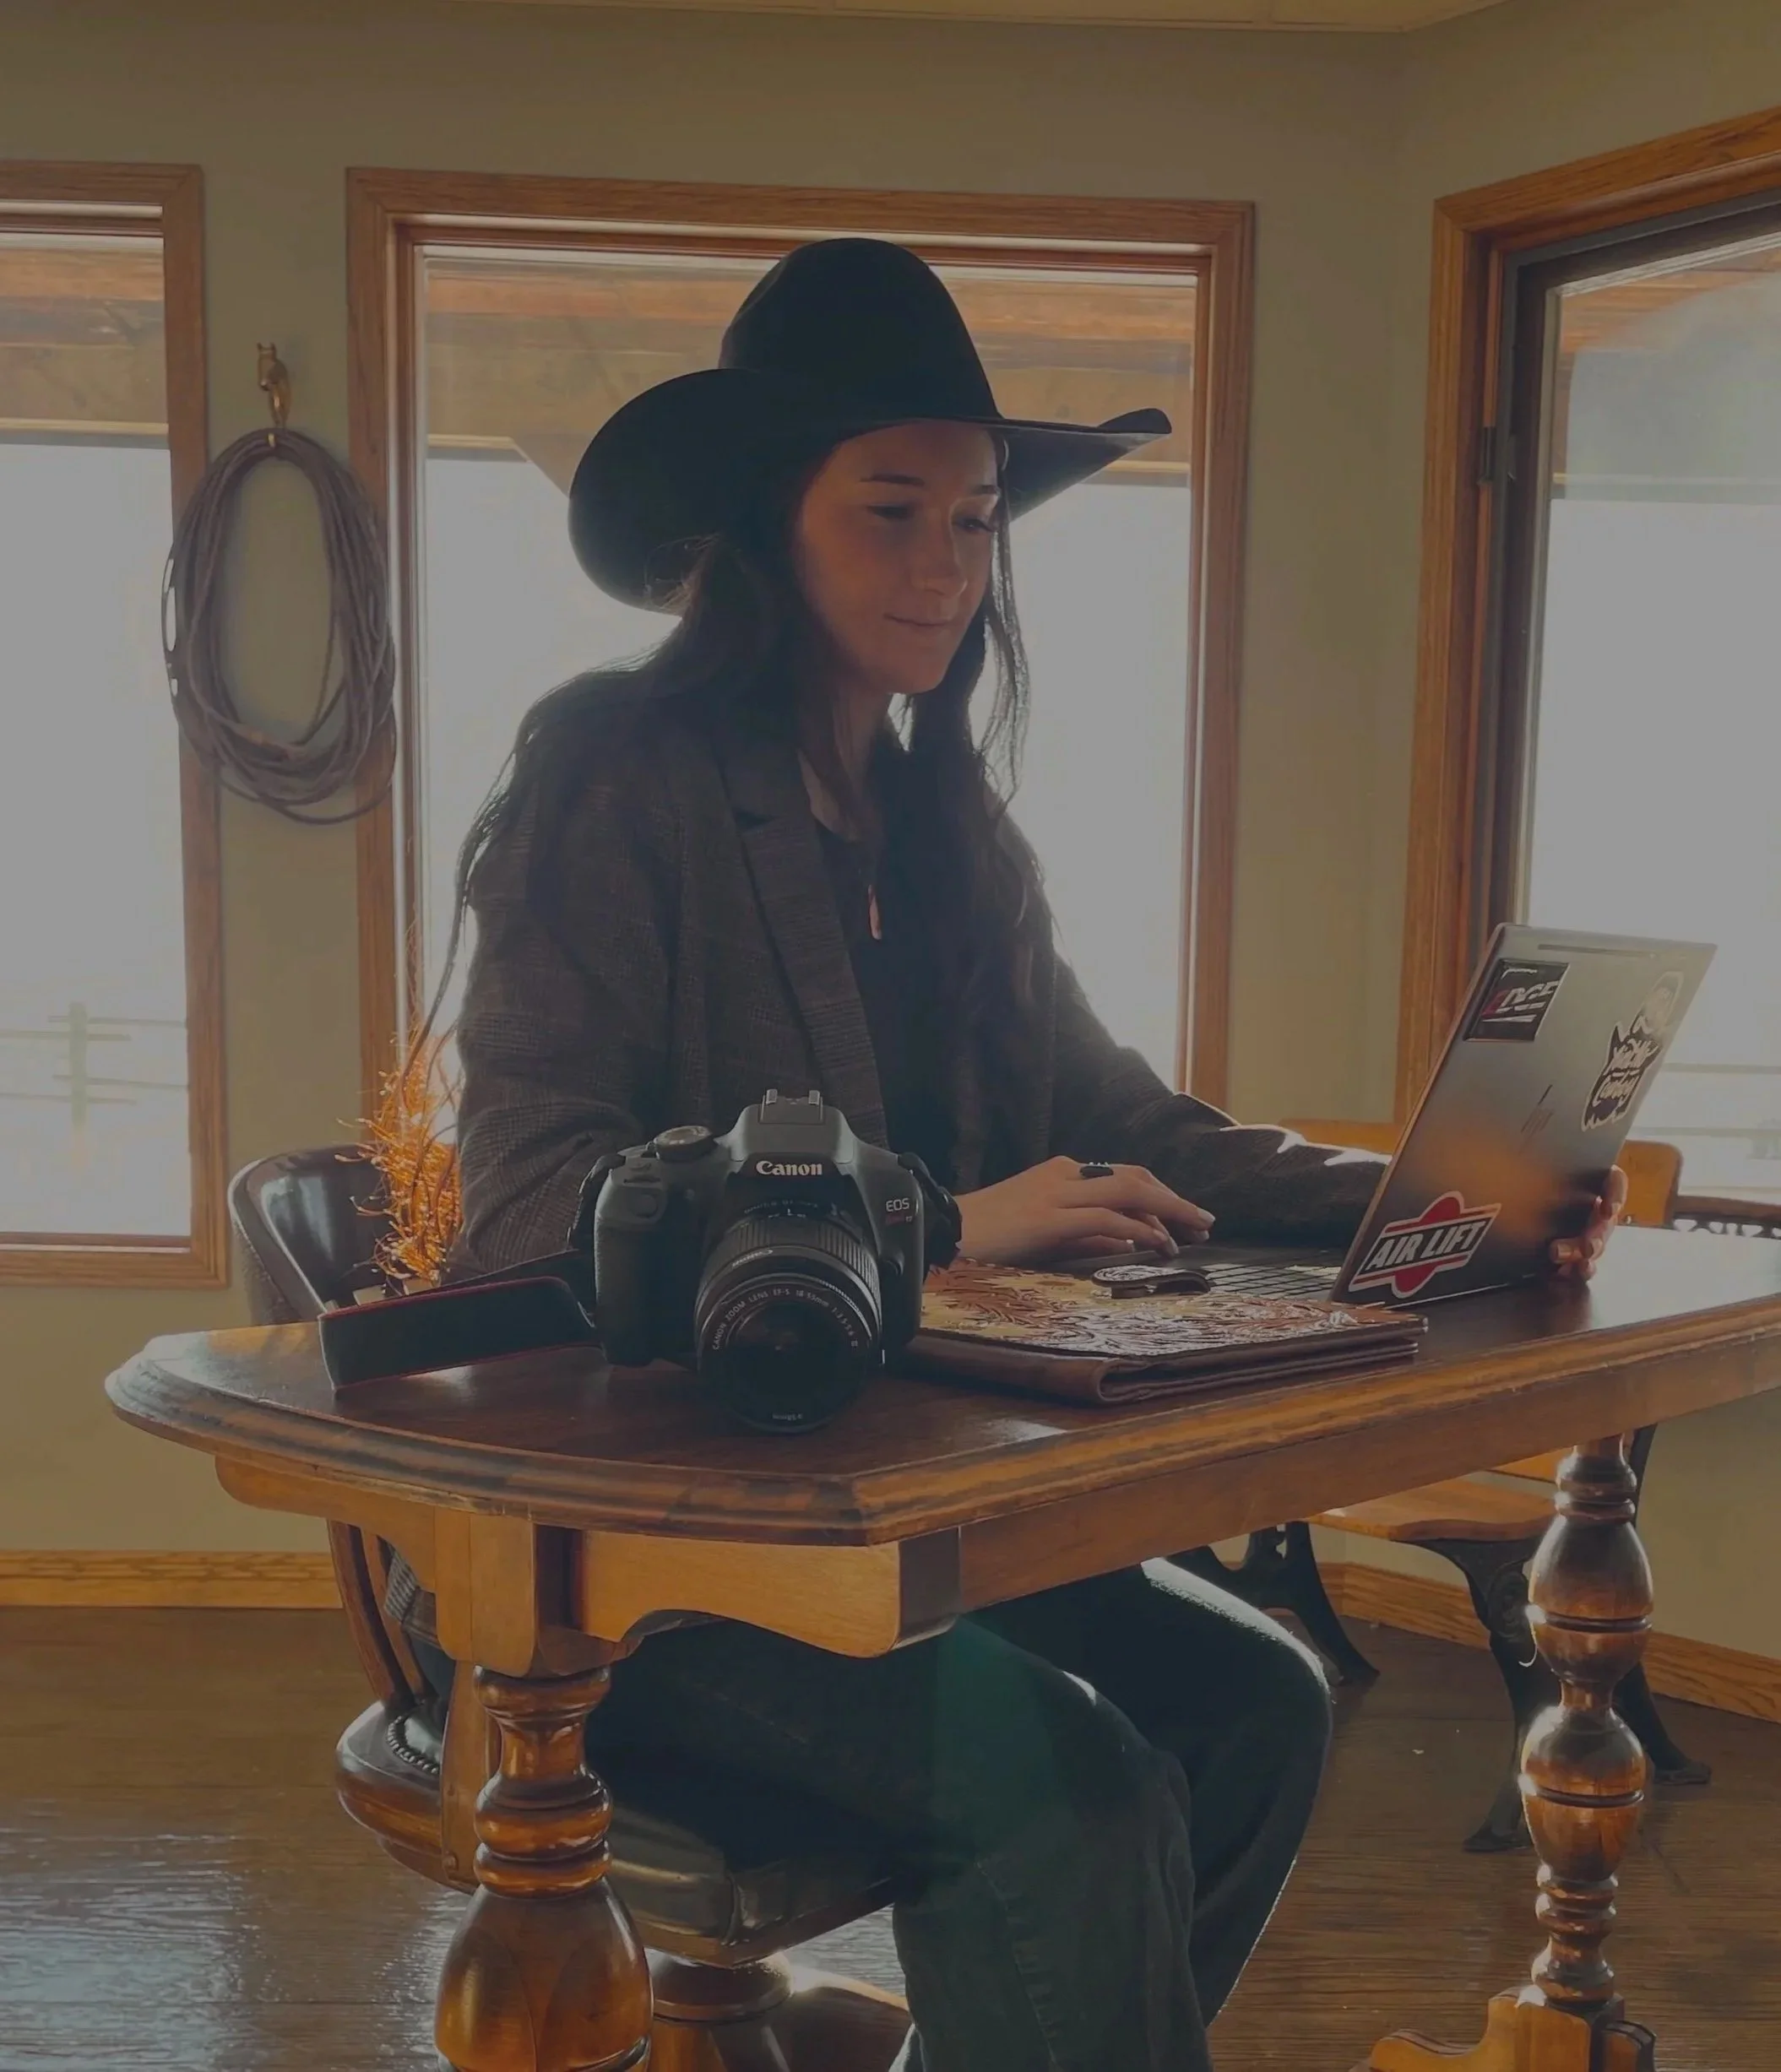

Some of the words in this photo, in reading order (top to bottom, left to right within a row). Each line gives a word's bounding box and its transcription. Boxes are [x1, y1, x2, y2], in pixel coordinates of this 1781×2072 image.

[755, 1160, 823, 1176] Canon
[886, 1197, 910, 1212] EOS
[1364, 1233, 1424, 1272] AIR
[1420, 1221, 1487, 1259] LIFT
[712, 1323, 727, 1351] CANON
[725, 1300, 746, 1321] ZOOM
[748, 1290, 769, 1303] LENS
